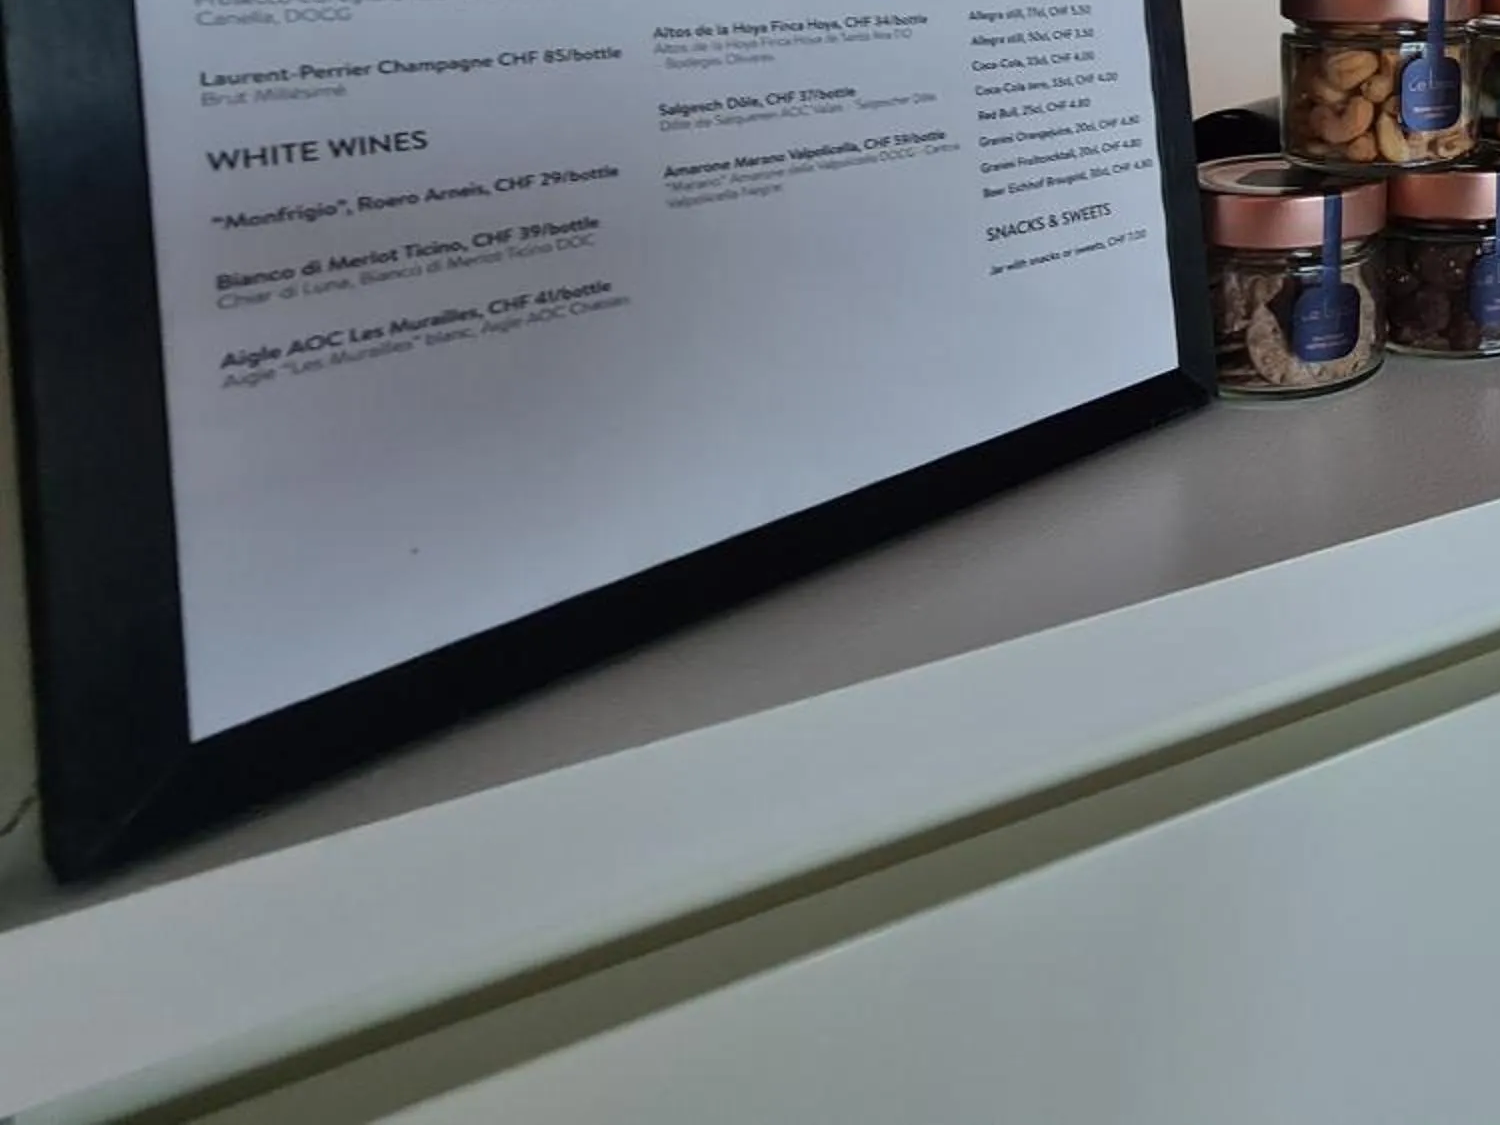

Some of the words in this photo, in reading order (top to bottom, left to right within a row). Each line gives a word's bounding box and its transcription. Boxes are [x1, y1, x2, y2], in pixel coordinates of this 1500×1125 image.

[1048, 5, 1068, 17] CHF
[653, 26, 691, 38] Altos
[695, 24, 713, 36] de
[716, 23, 728, 35] la
[732, 22, 768, 37] Hoya
[770, 20, 804, 32] Finca
[845, 16, 872, 27] CHF
[1052, 28, 1072, 40] CHF
[377, 56, 493, 74] Champagne
[497, 50, 539, 66] CHF
[543, 46, 623, 64] 85/bottle
[1051, 51, 1072, 64] CHF
[975, 82, 1025, 96] Coca-Cola
[1075, 73, 1095, 85] CHF
[766, 90, 796, 105] CHF
[978, 110, 997, 120] Red
[1046, 100, 1067, 112] CHF
[1099, 118, 1119, 130] CHF
[207, 140, 319, 171] WHITE
[328, 130, 428, 159] WINES
[663, 162, 730, 179] Amarone
[863, 136, 891, 151] CHF
[1101, 140, 1121, 153] CHF
[1112, 162, 1131, 174] CHF
[357, 193, 420, 212] Roero
[424, 182, 492, 203] Arneis,
[494, 174, 536, 192] CHF
[539, 164, 620, 187] 29/bottle
[986, 216, 1045, 242] SNACKS
[1048, 213, 1058, 228] &
[1061, 202, 1112, 226] SWEETS
[216, 267, 296, 291] Bianco
[301, 259, 322, 276] di
[328, 249, 399, 271] Merlot
[405, 240, 469, 259] Ticino,
[471, 228, 514, 248] CHF
[519, 216, 600, 240] 39/bottle
[220, 346, 282, 369] Aigle
[286, 330, 345, 357] AOC
[350, 327, 385, 343] Les
[389, 307, 484, 337] Murailles,
[487, 293, 532, 315] CHF
[535, 279, 613, 305] 41/bottle
